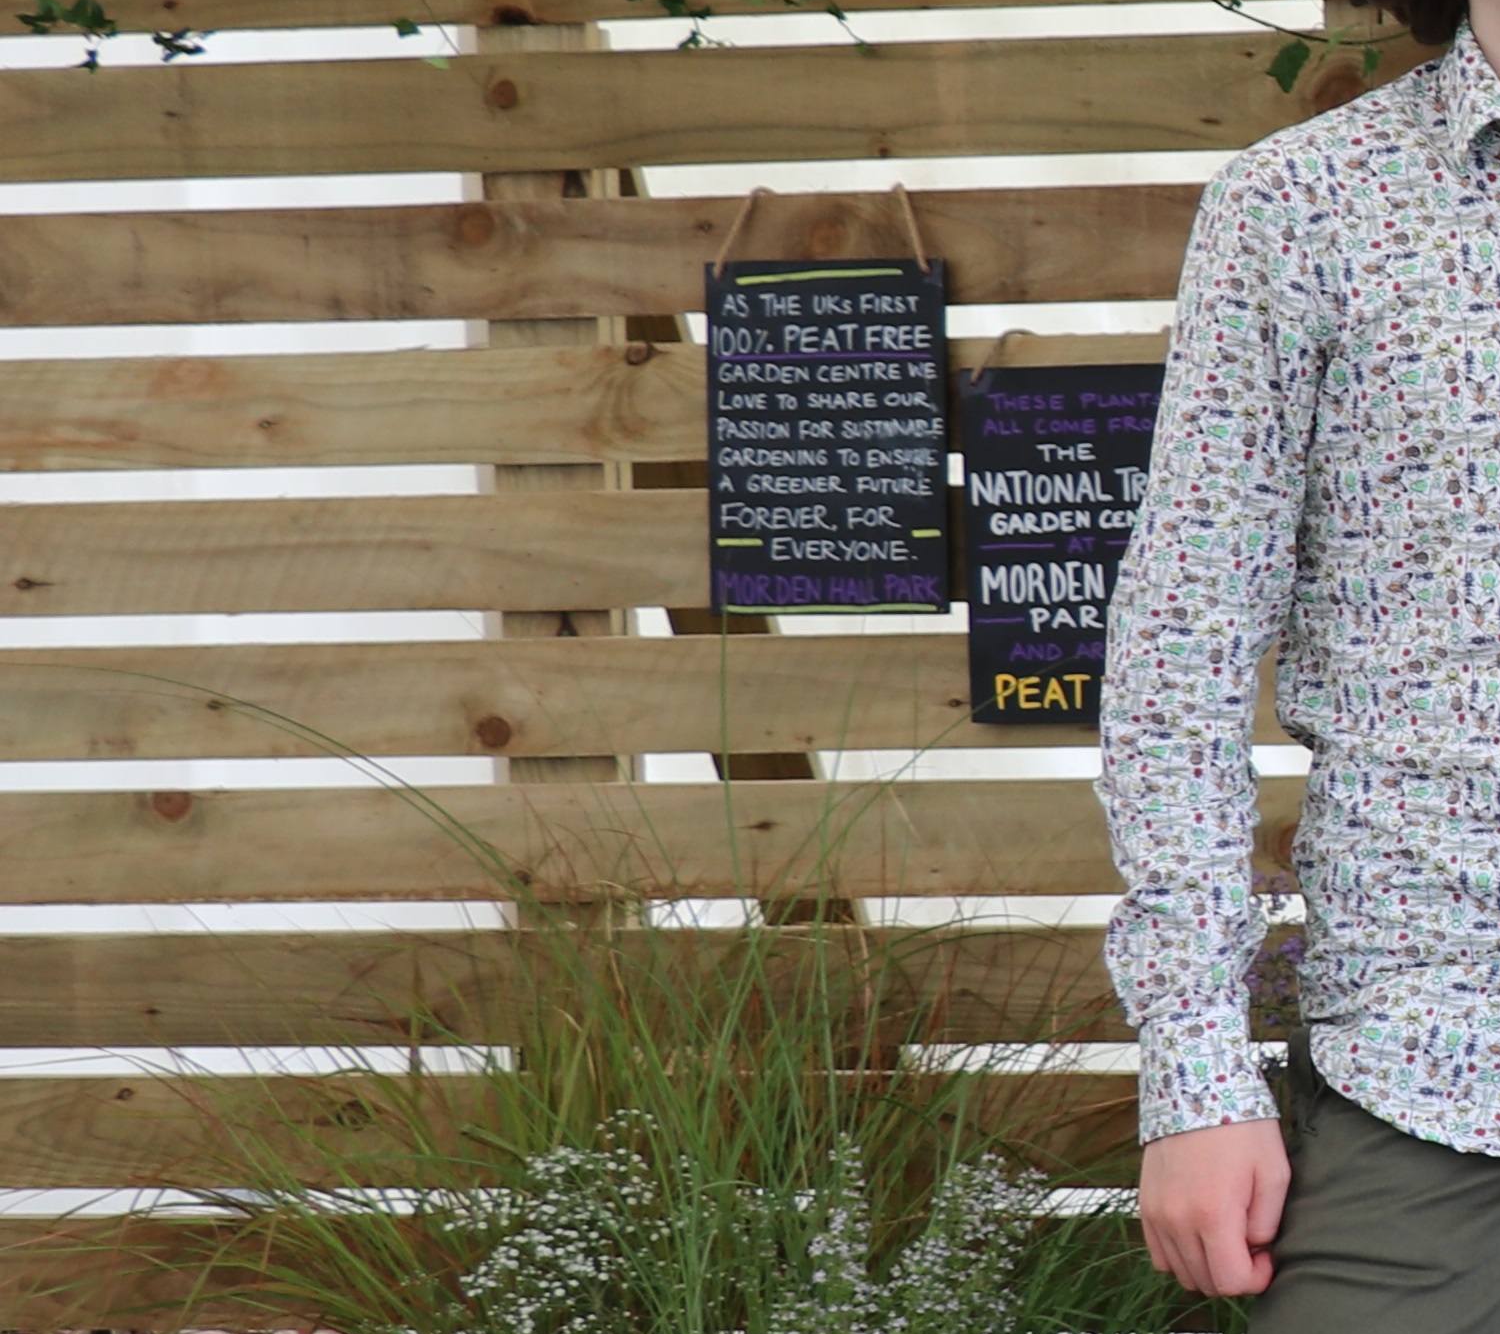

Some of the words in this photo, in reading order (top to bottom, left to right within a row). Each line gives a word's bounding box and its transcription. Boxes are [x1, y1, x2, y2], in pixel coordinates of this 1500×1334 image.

[722, 293, 750, 317] AS
[758, 293, 802, 316] THE
[858, 293, 921, 314] FIRST
[783, 323, 860, 353] PEAT
[864, 324, 933, 351] FREE
[717, 362, 811, 384] GARDEN
[816, 363, 903, 383] CENTRE
[907, 361, 938, 379] WE
[717, 389, 768, 411] LOVE
[775, 393, 799, 410] TO
[806, 391, 878, 409] SHARE
[986, 392, 1065, 411] THESE
[716, 417, 791, 441] PASSION
[799, 419, 836, 440] FOR
[982, 418, 1023, 437] ALL
[1034, 418, 1097, 435] COME
[1107, 415, 1154, 433] FRO
[717, 447, 829, 467] GARDENING
[836, 448, 861, 466] TO
[1034, 442, 1098, 462] THE
[717, 474, 735, 493] A
[745, 474, 848, 494] GREENER
[856, 475, 935, 496] FUTURE
[969, 469, 1115, 507] NATIONAL
[1113, 466, 1149, 503] TR
[845, 504, 902, 530] FOR
[989, 509, 1092, 535] GARDEN
[1097, 508, 1138, 529] CEN
[769, 536, 919, 561] EVERYONE.
[1067, 536, 1096, 553] AT
[716, 570, 823, 604] MORDEN
[829, 576, 881, 602] HALL
[884, 572, 942, 601] PARK
[980, 560, 1106, 605] MORDEN
[1028, 604, 1106, 634] PAR
[1008, 642, 1063, 662] AND
[1074, 640, 1106, 659] AR
[994, 672, 1092, 710] PEAT
